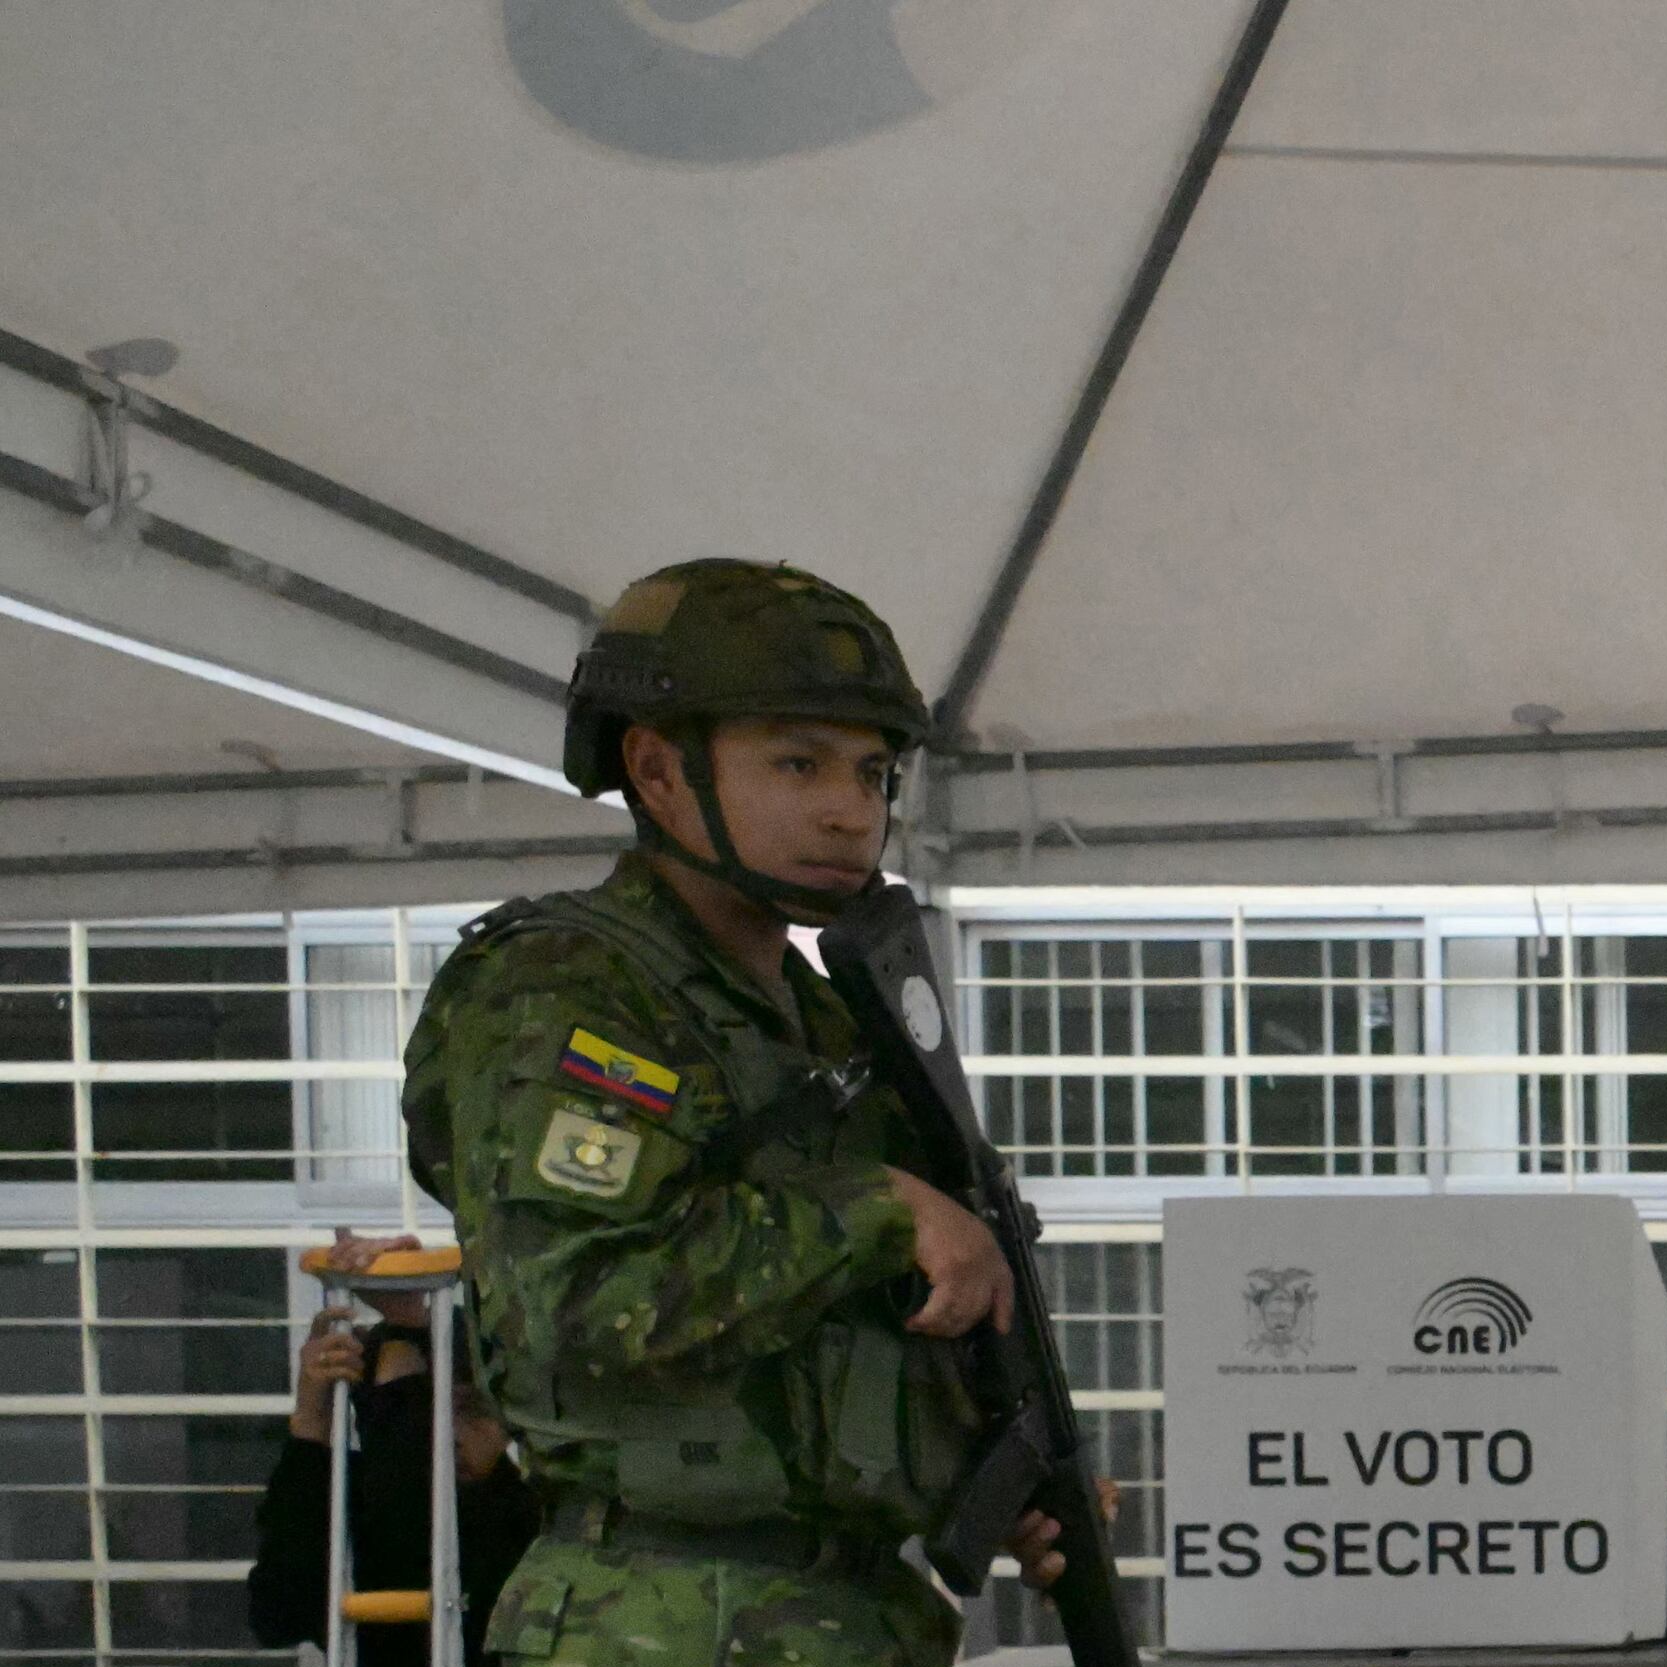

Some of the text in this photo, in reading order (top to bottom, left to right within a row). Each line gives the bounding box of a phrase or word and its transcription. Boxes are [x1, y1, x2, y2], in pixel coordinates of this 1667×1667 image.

[1248, 1429, 1533, 1487] EL VOTO
[1174, 1519, 1610, 1578] ES SECRETO
